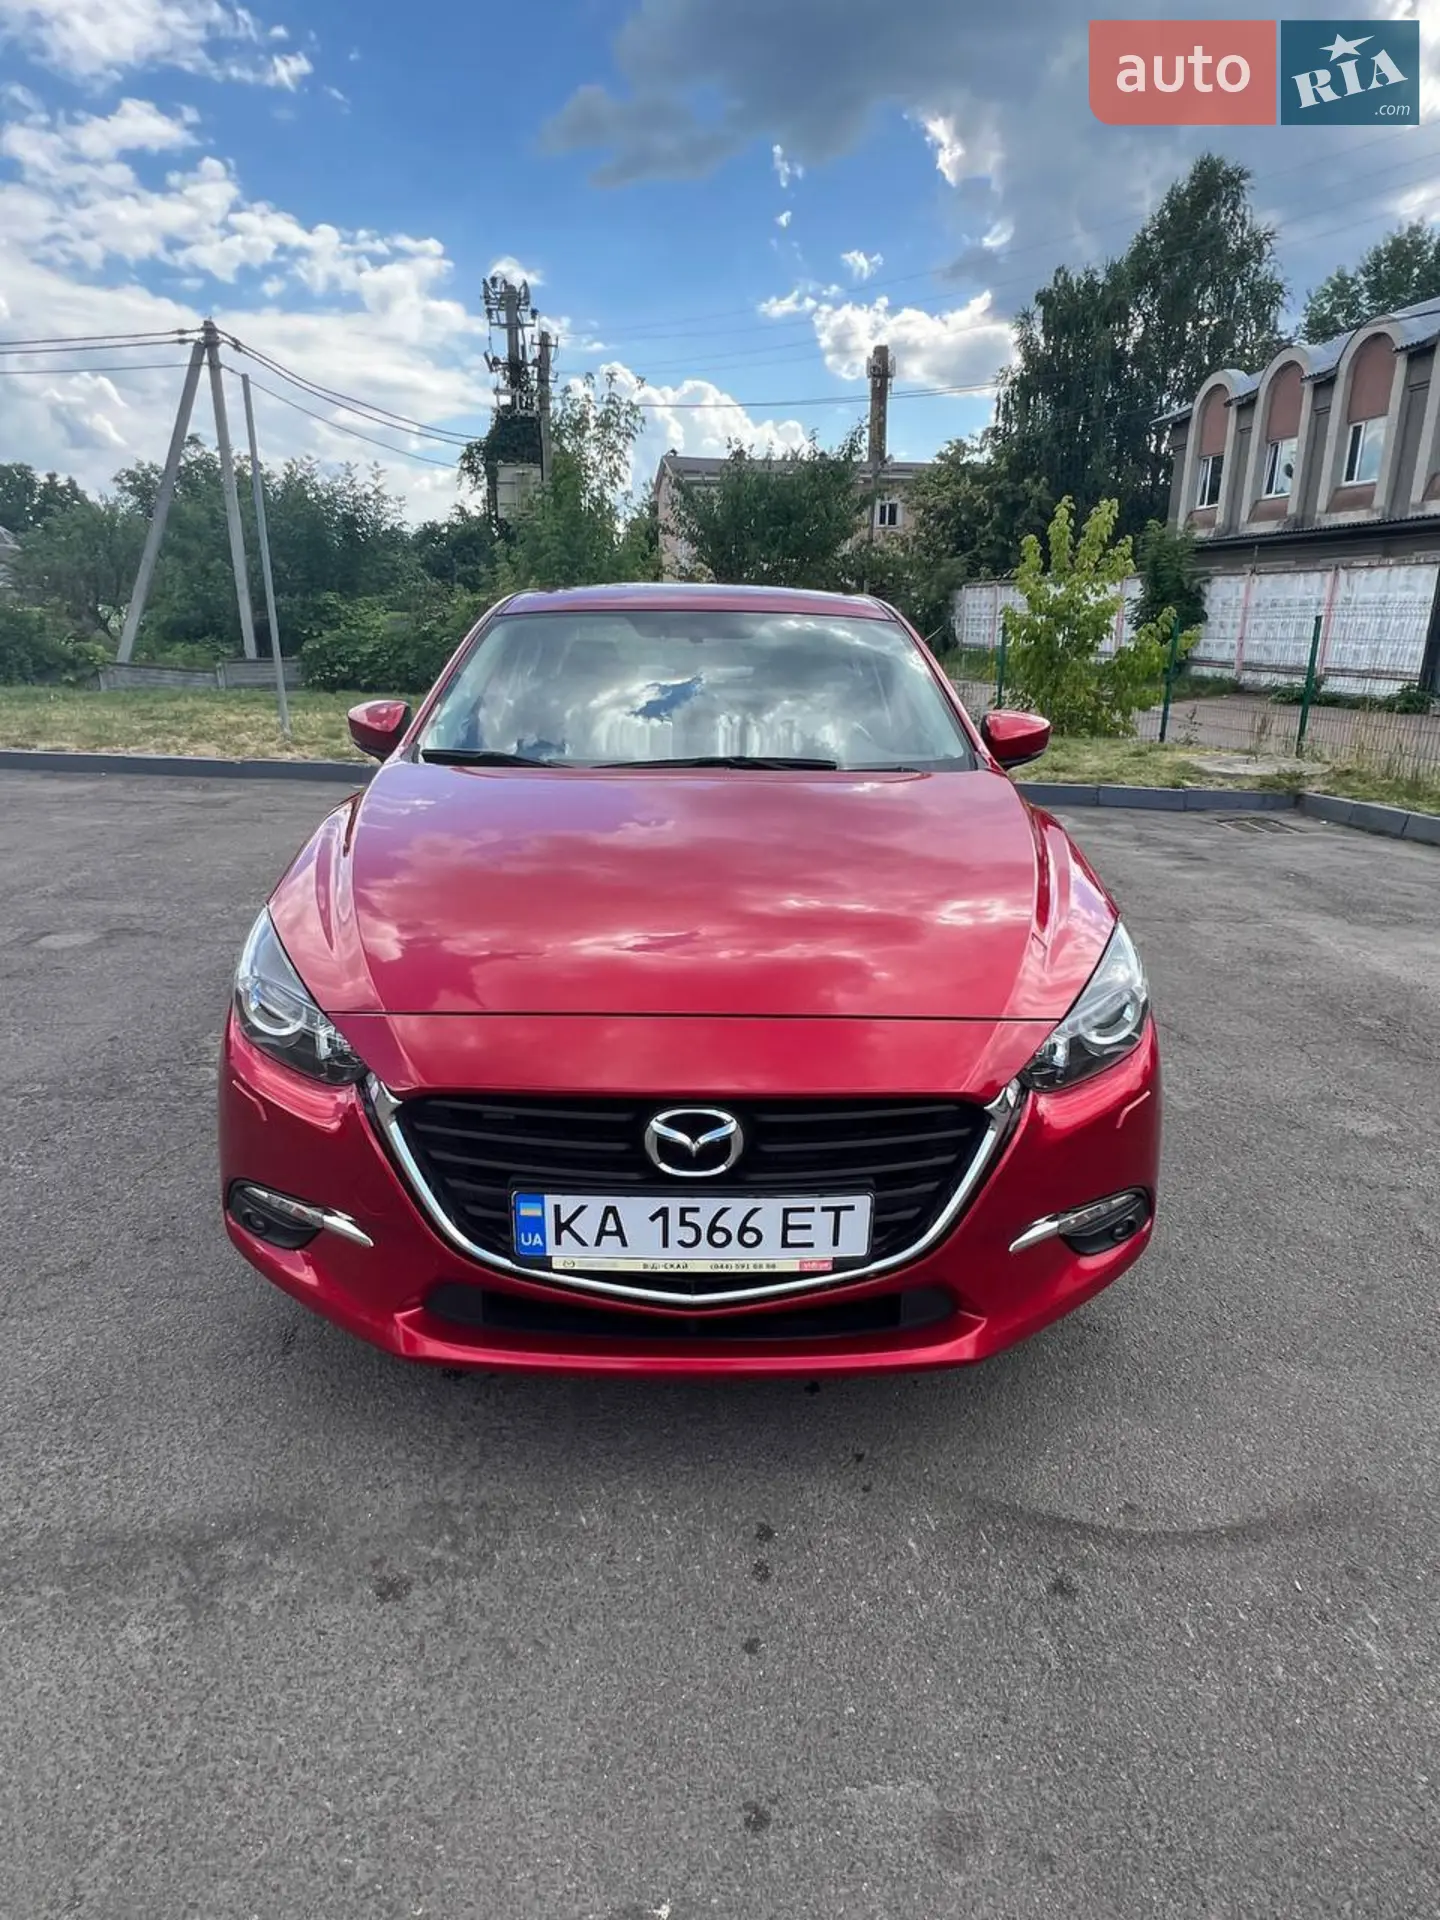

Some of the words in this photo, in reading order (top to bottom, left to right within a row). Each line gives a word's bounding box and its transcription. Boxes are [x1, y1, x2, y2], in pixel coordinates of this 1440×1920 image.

[521, 1232, 544, 1247] UA
[554, 1204, 629, 1248] KA
[649, 1206, 765, 1249] 1566
[780, 1205, 856, 1249] ET
